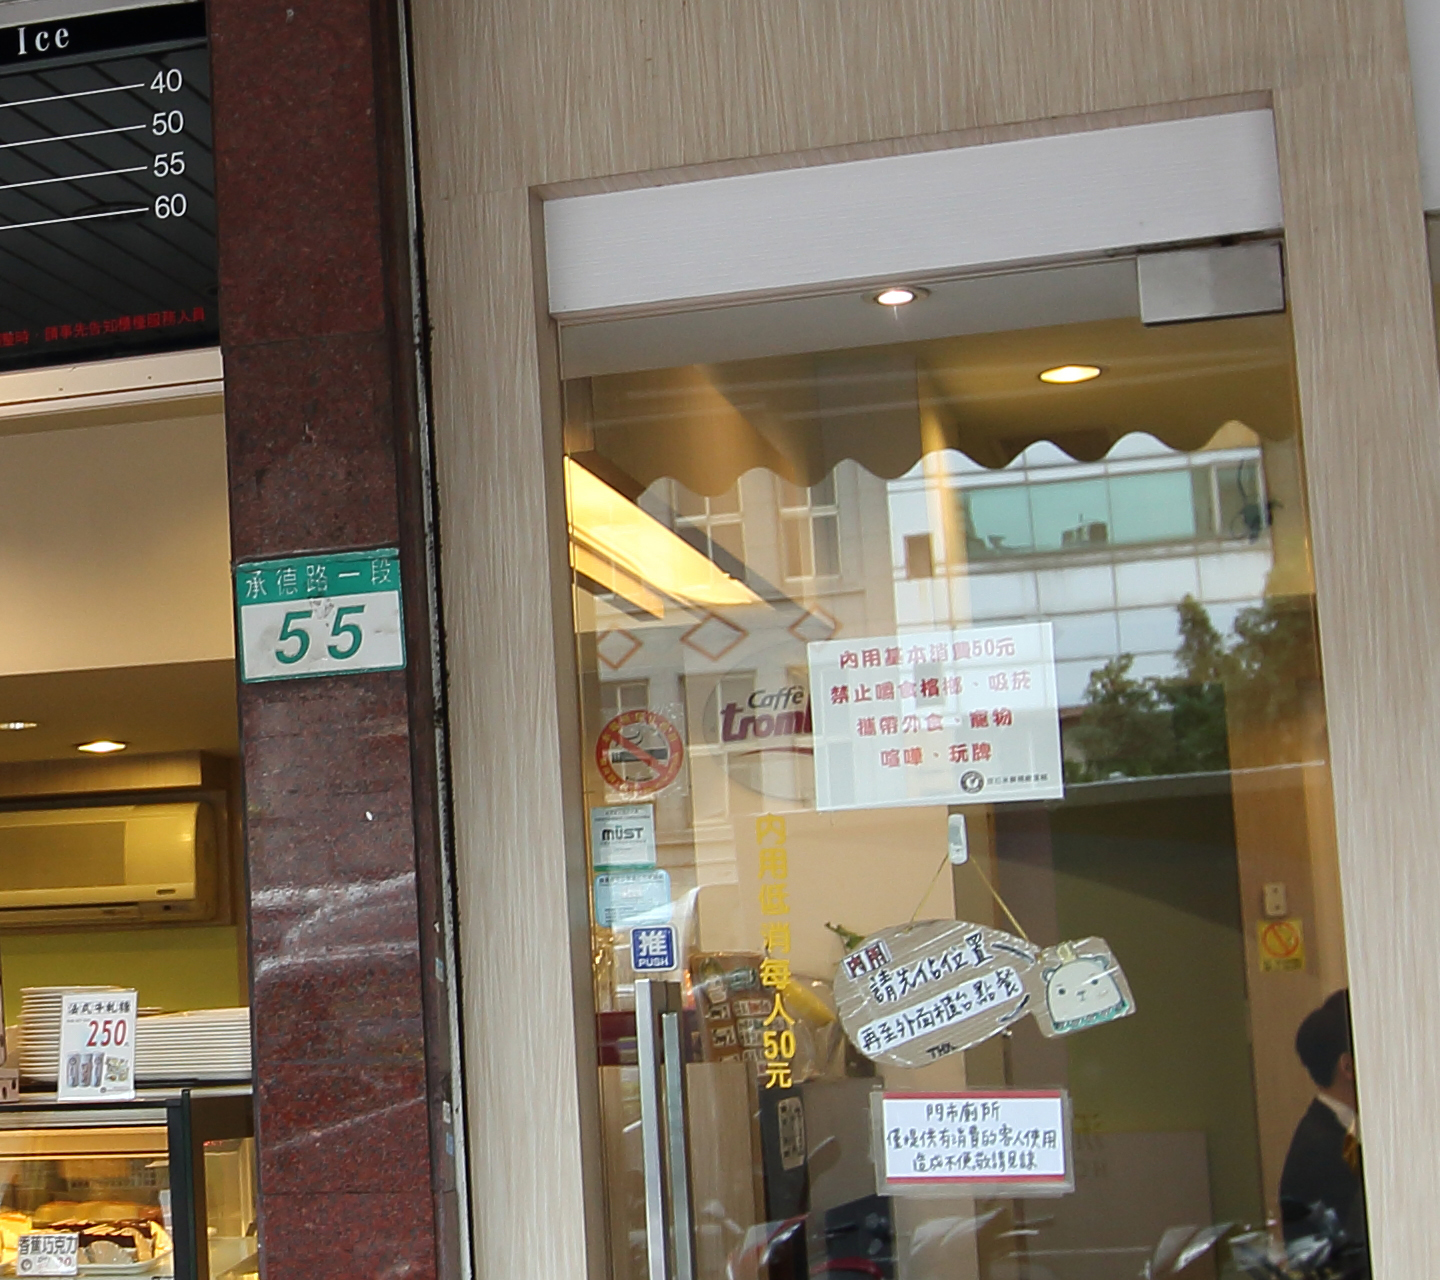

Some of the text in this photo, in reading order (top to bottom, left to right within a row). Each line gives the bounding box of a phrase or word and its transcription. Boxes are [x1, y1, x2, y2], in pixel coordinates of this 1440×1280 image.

[17, 25, 71, 56] Ice
[149, 68, 184, 96] 40
[150, 110, 185, 137] 50
[151, 151, 186, 178] 55
[152, 193, 187, 219] 60
[245, 558, 391, 599] 承德路一段
[275, 604, 367, 664] 55
[748, 685, 804, 709] Caffè
[639, 930, 668, 956] 推
[639, 957, 668, 967] PUSH
[86, 1019, 127, 1048] 250
[18, 1235, 78, 1256] 香蕉巧克力
